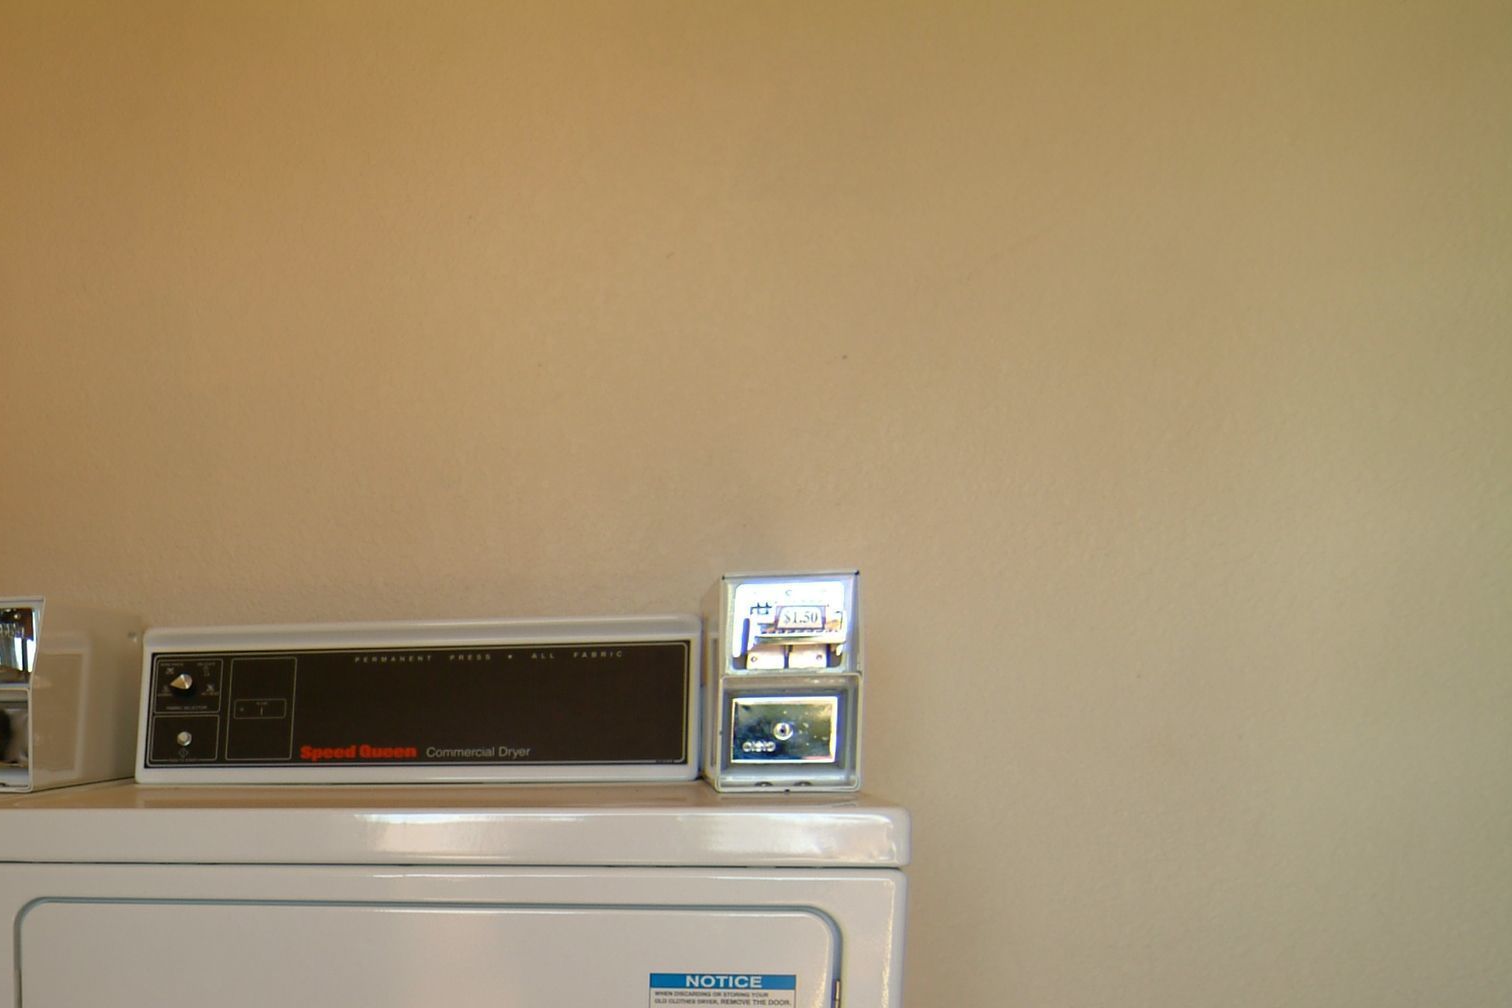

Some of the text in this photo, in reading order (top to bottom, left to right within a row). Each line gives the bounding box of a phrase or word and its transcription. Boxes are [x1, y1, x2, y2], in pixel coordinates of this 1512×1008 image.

[783, 611, 818, 624] $1.50
[355, 655, 432, 663] PERMANENT
[573, 650, 623, 659] FABRIC
[300, 744, 417, 761] Speed Queen
[426, 746, 530, 759] Commercial Dryer
[686, 975, 762, 988] NOTICE
